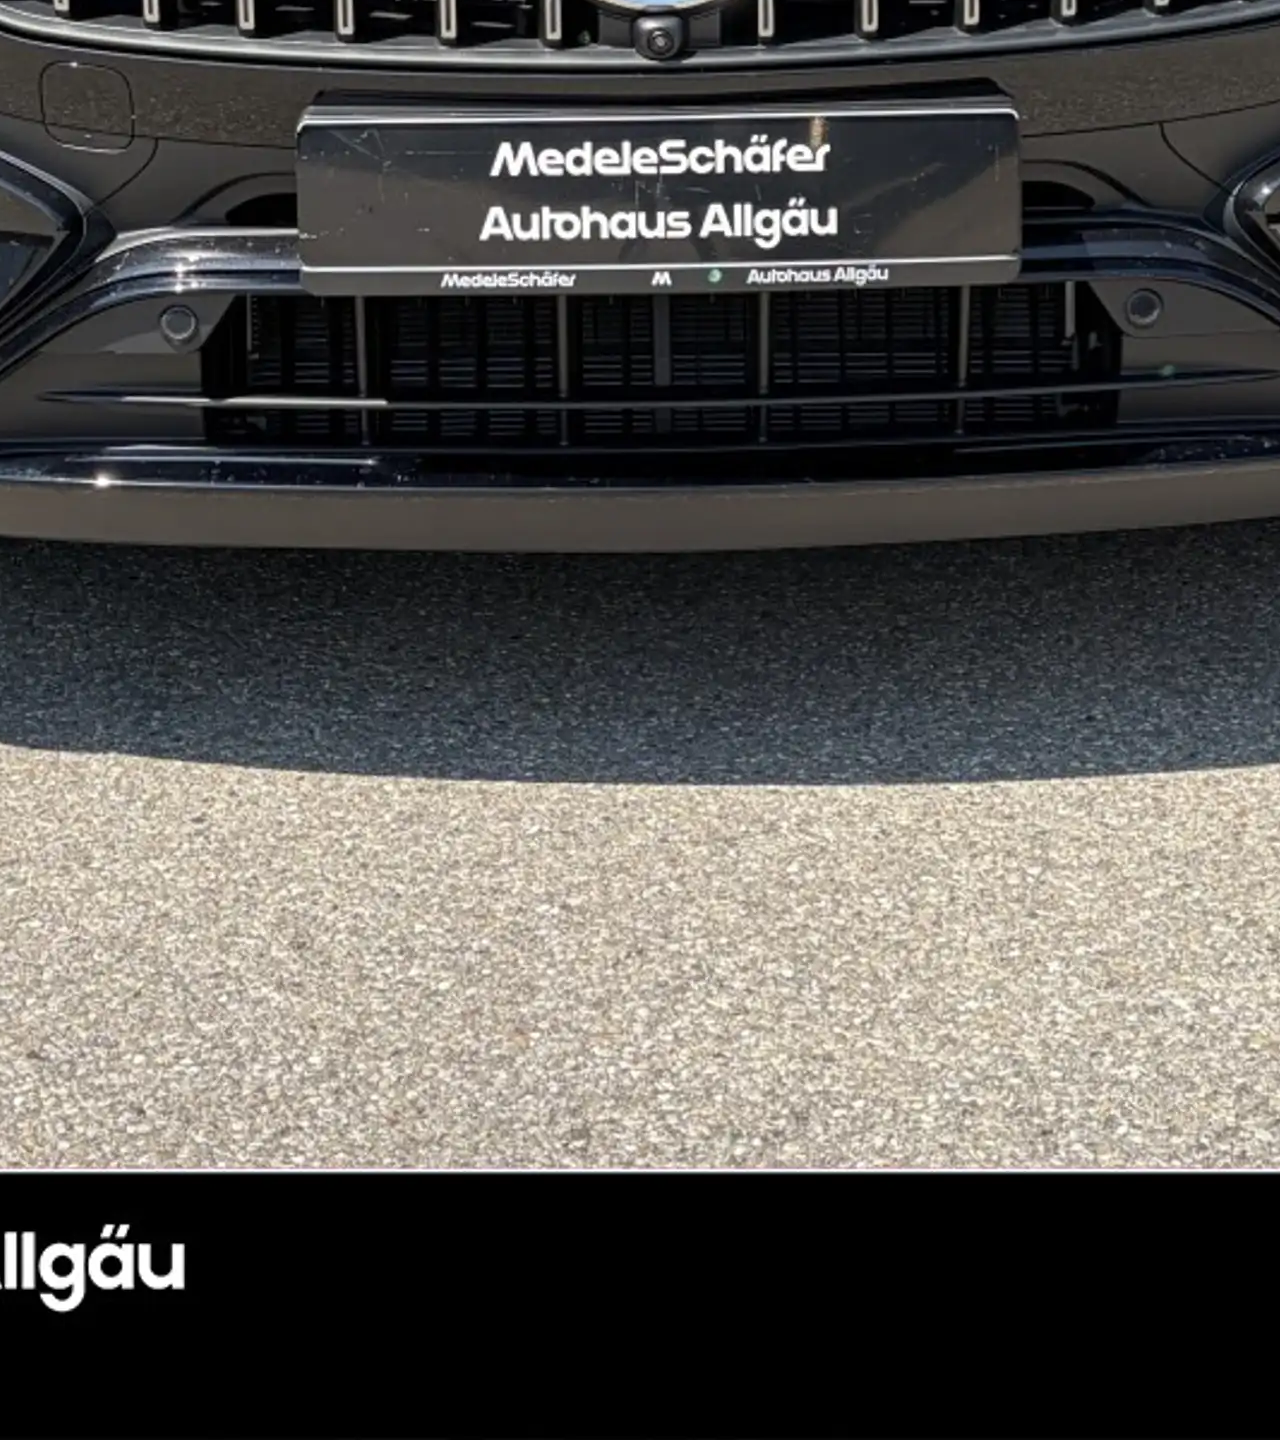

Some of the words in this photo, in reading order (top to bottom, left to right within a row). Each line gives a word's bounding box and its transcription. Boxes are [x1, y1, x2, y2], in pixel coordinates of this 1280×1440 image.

[490, 136, 830, 177] MedeleSchäfer
[479, 205, 692, 243] Autohaus
[700, 197, 838, 249] Allgäu
[440, 270, 577, 289] MedeleSchäfer
[746, 268, 830, 285] Autohaus
[832, 263, 889, 287] Allgäu
